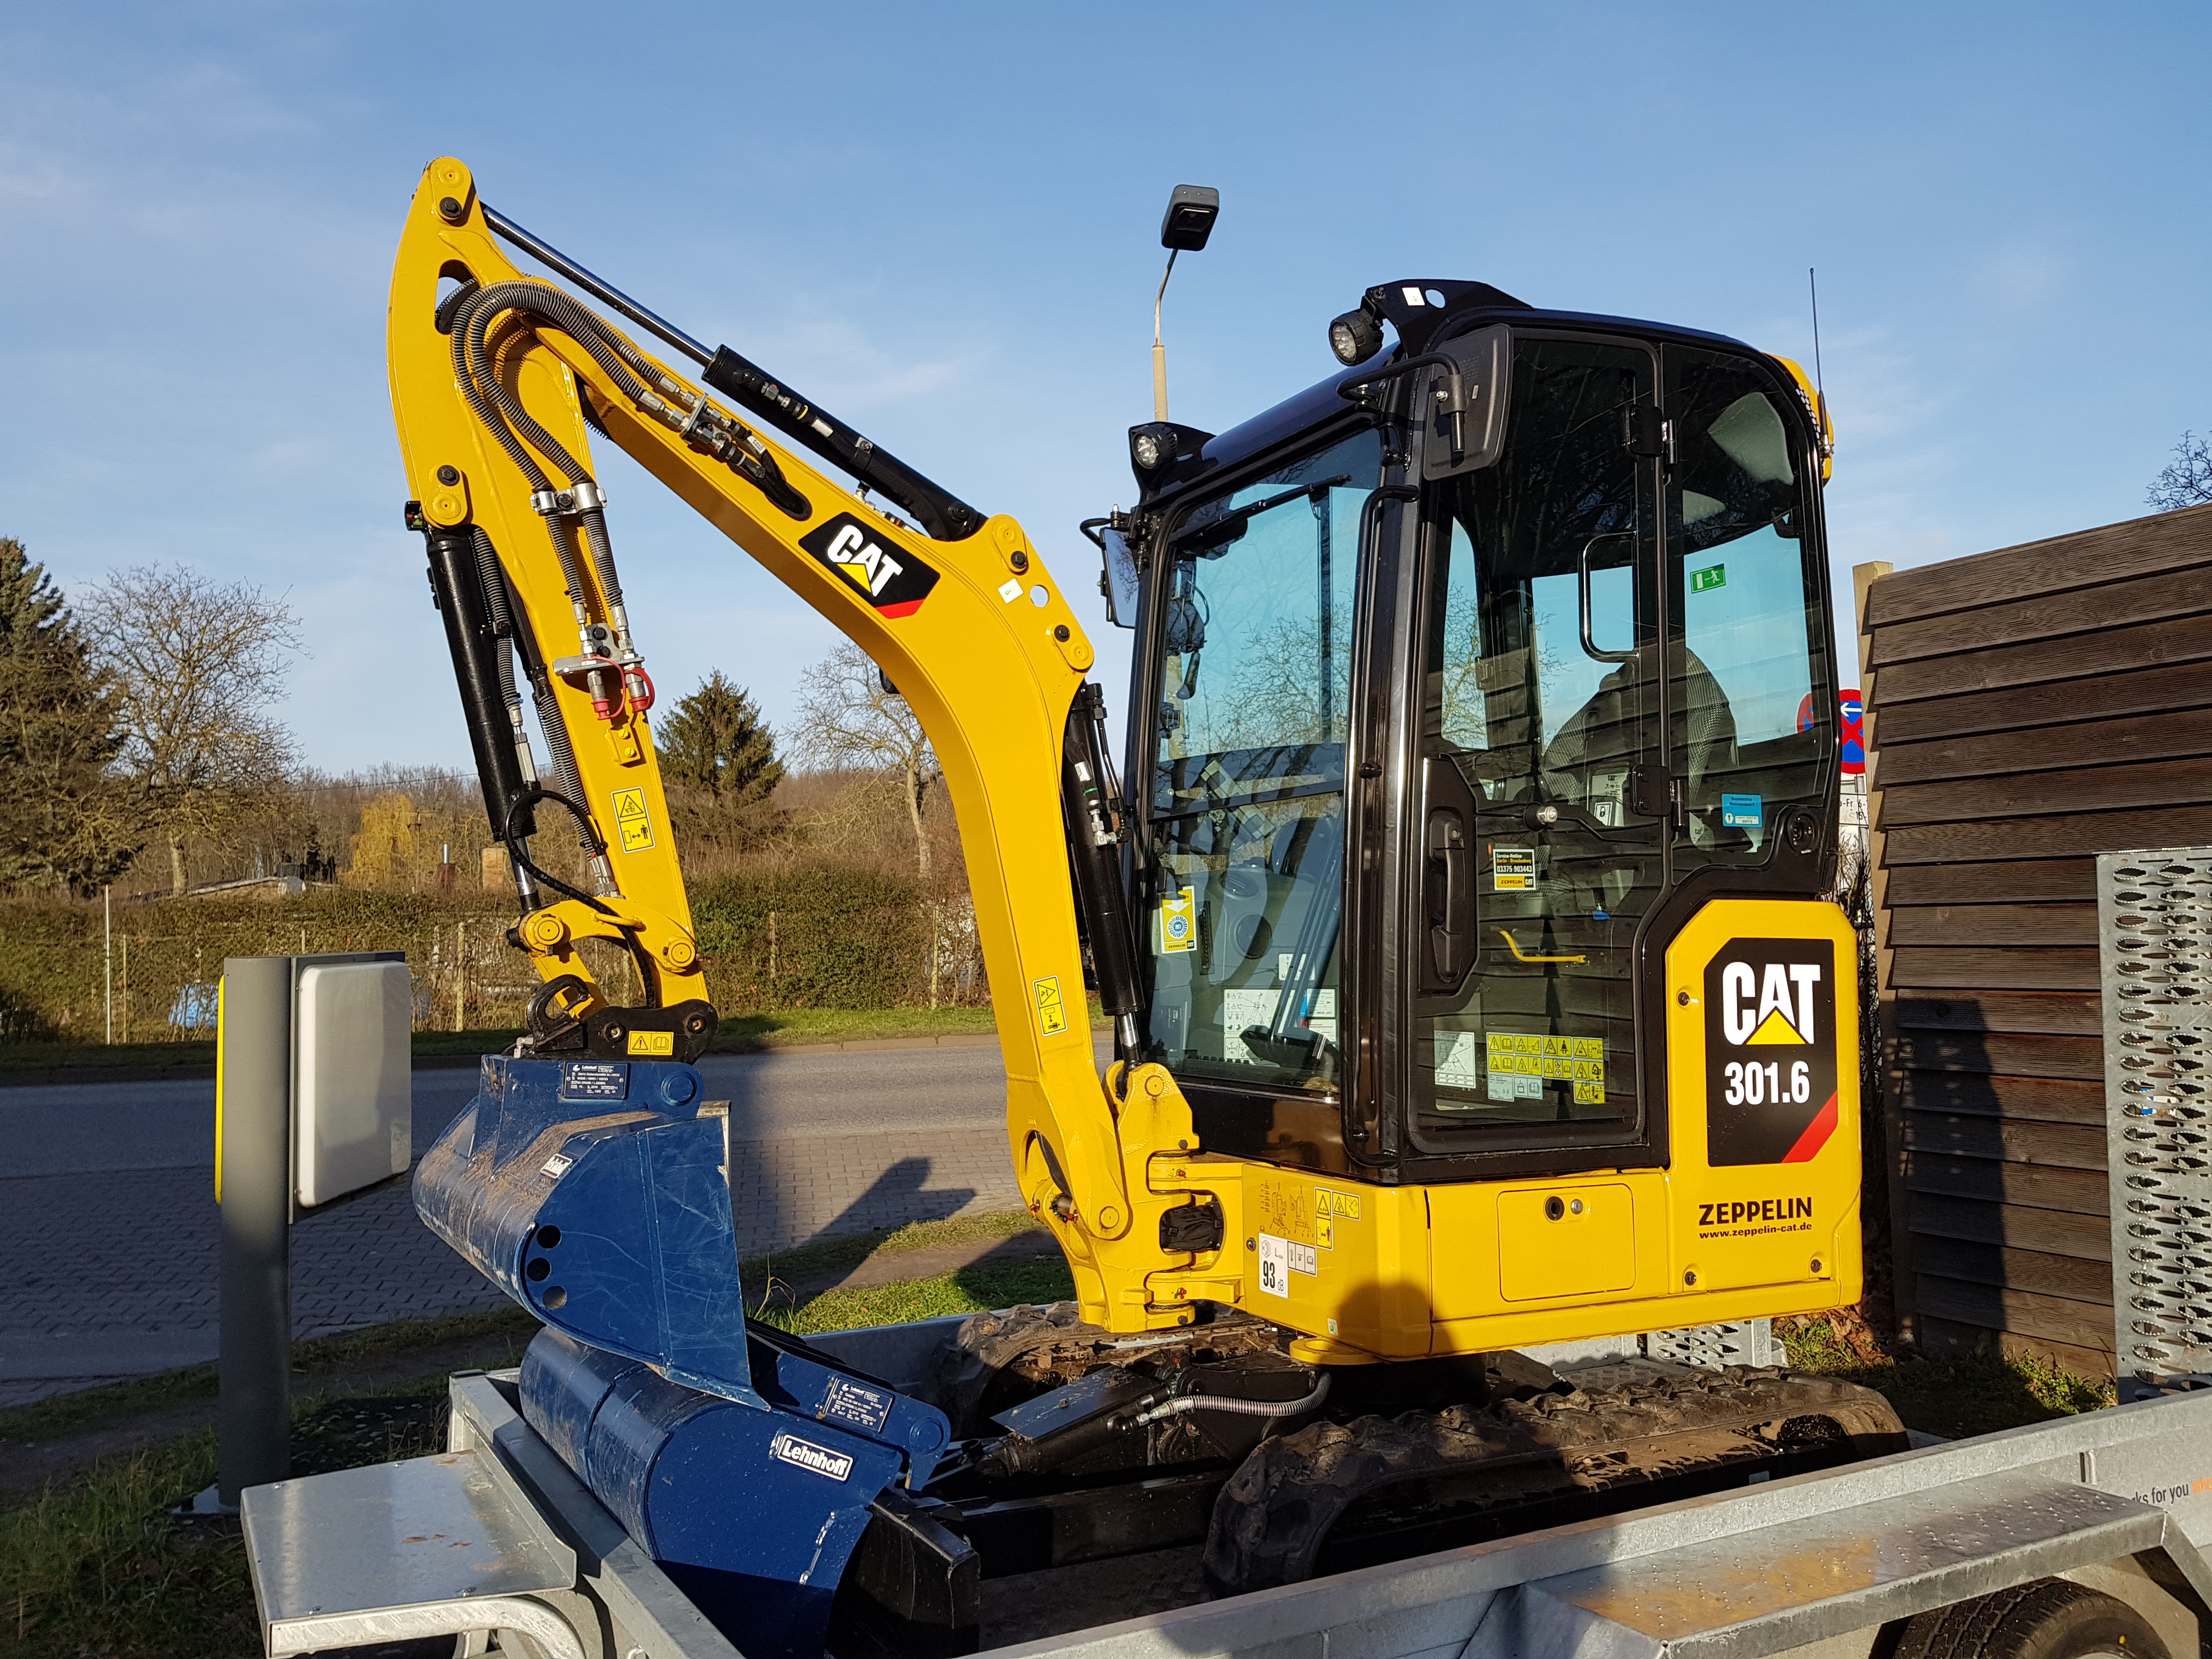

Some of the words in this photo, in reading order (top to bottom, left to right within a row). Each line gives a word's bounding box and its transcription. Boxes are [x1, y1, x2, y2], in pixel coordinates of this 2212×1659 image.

[827, 524, 904, 597] CAT
[1839, 799, 1853, 808] o-Fr
[1722, 961, 1821, 1045] CAT
[1724, 1060, 1810, 1106] 301.6
[1699, 1197, 1812, 1226] ZEPPELIN
[1699, 1222, 1812, 1239] www.zeppelin-cat.de
[1263, 1260, 1276, 1289] 93
[1277, 1279, 1284, 1291] dB
[782, 1440, 848, 1476] Lehnhoff
[2151, 1487, 2166, 1504] for
[2169, 1483, 2189, 1504] you
